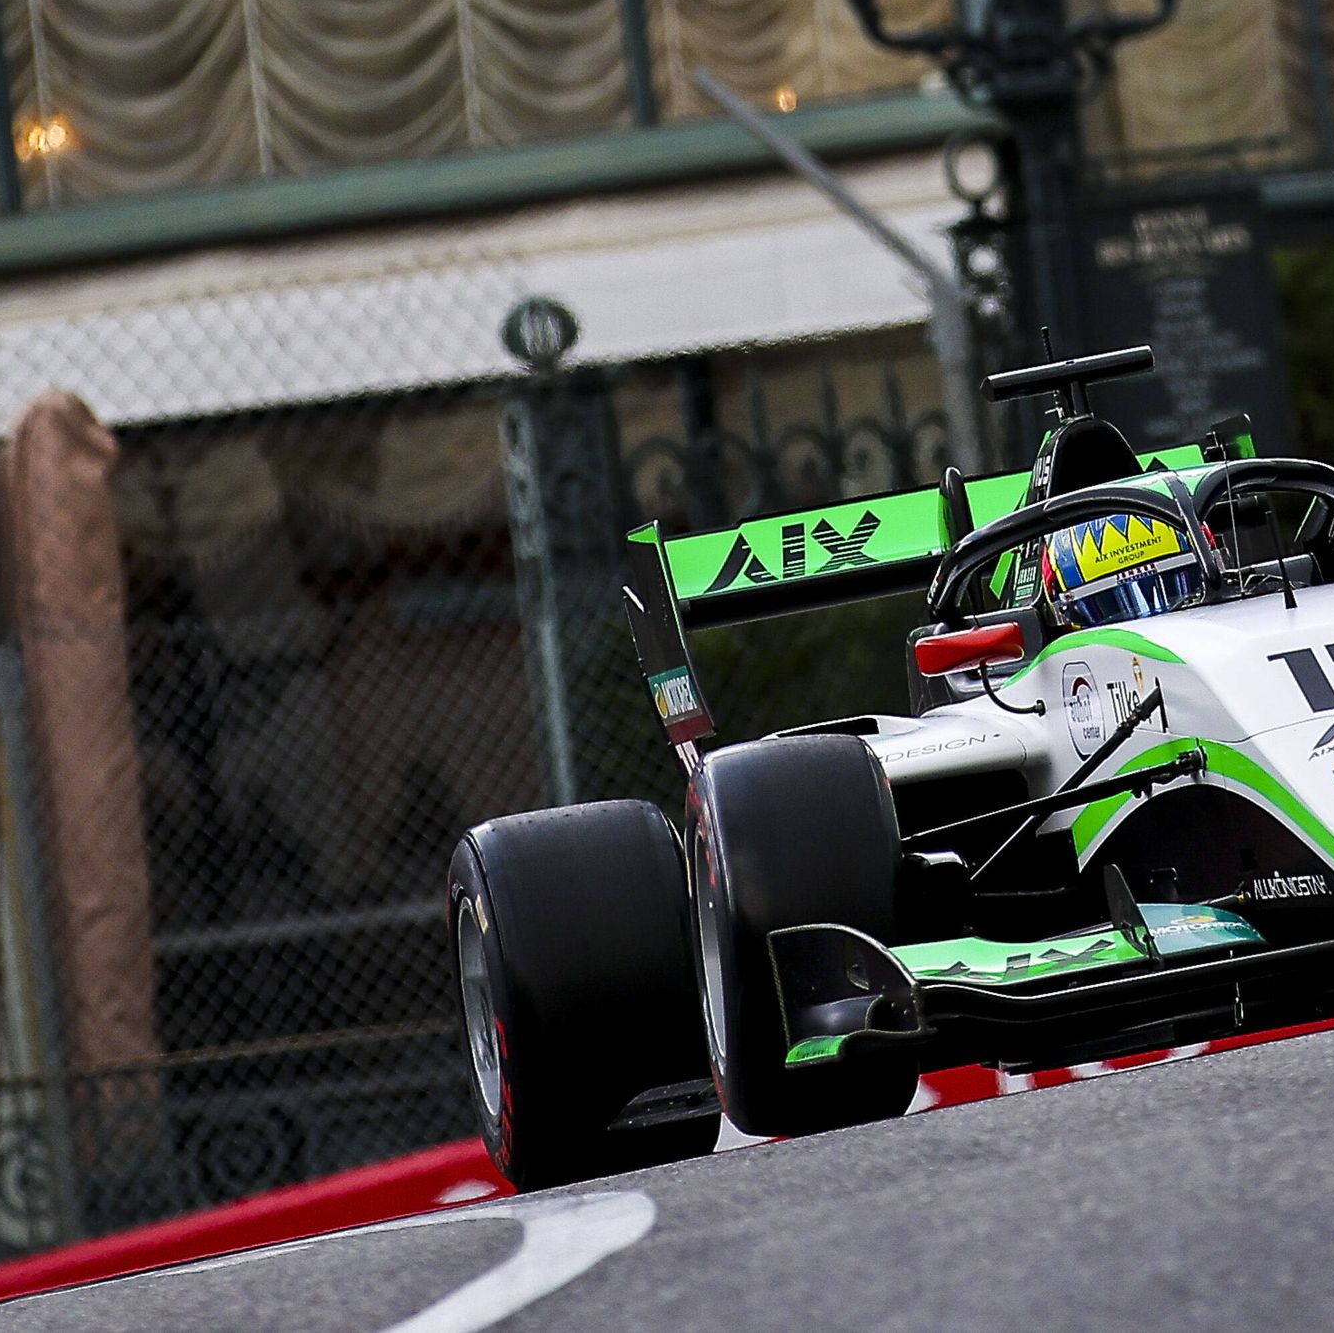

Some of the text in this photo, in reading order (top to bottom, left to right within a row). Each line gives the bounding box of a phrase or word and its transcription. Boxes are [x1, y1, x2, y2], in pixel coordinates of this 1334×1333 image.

[703, 509, 881, 594] AIX
[1095, 536, 1162, 564] AIX INVESTMENT
[1118, 551, 1145, 564] GROUP
